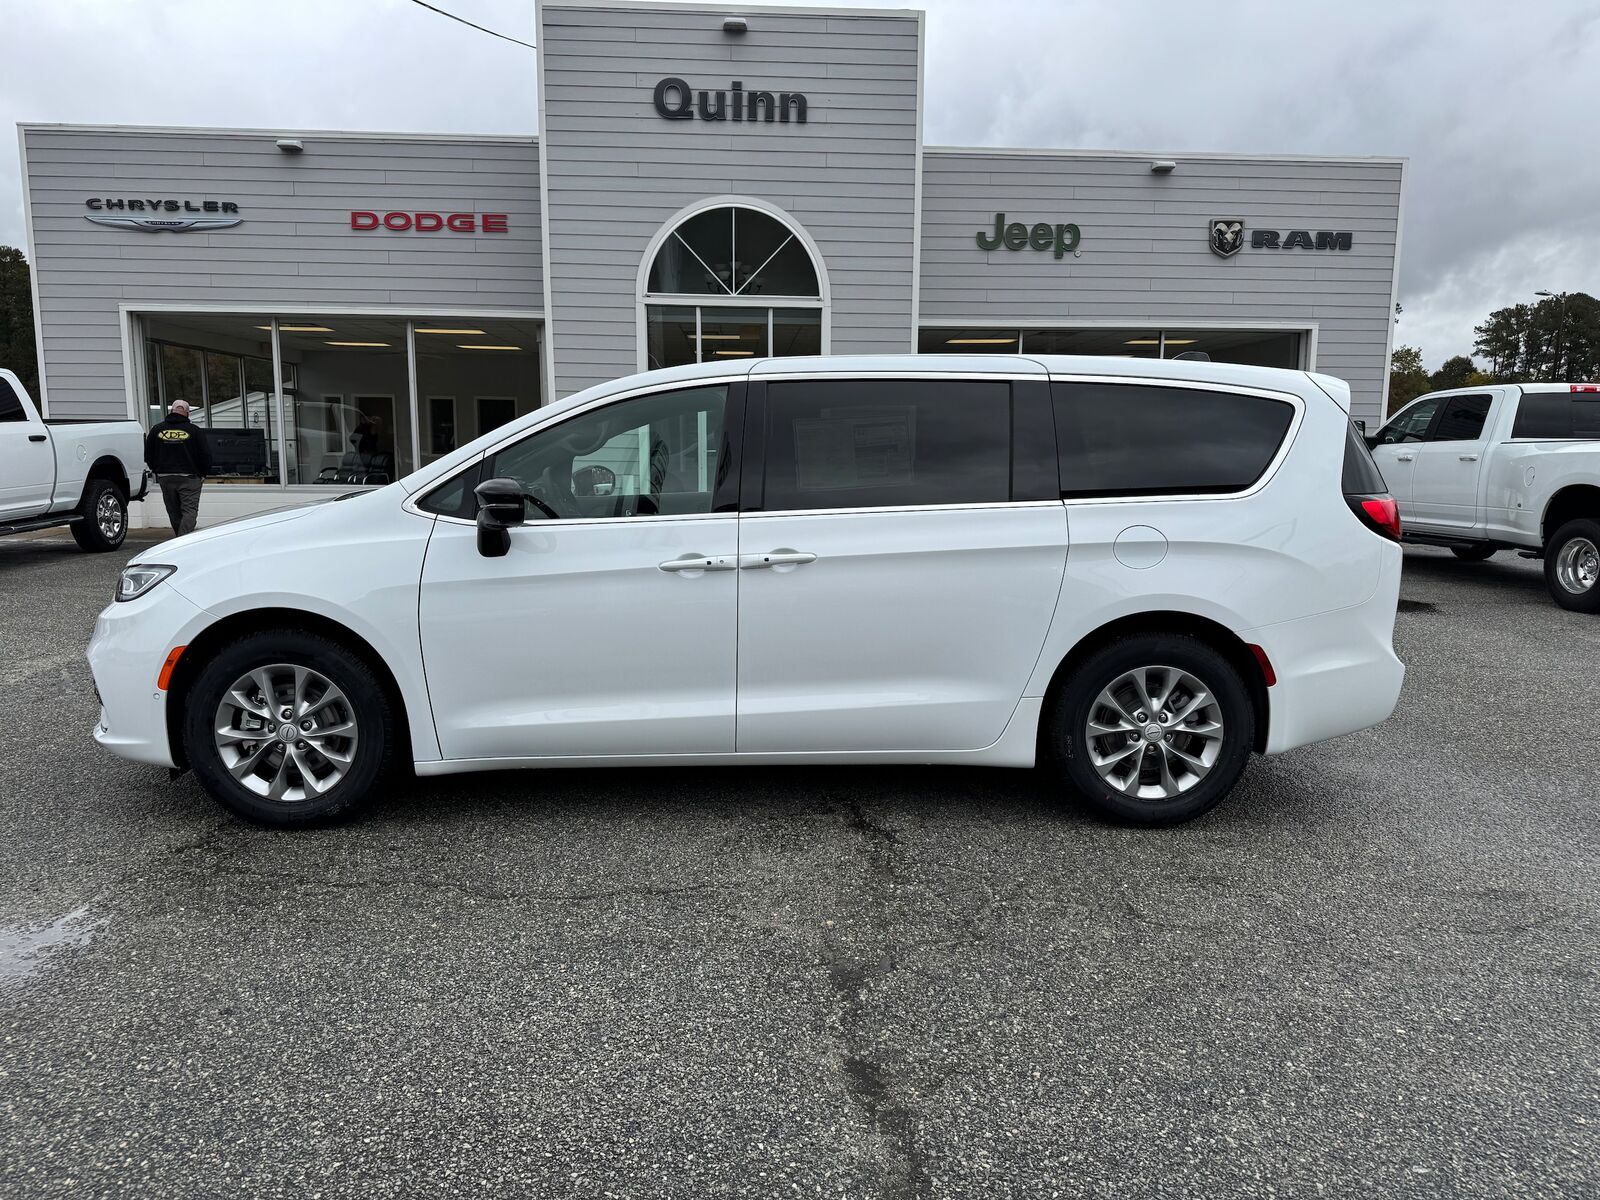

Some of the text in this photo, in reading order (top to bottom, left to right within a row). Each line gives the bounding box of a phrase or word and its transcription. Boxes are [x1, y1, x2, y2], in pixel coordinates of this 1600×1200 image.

[653, 77, 807, 123] Quinn
[85, 198, 239, 213] CHRYSLER
[351, 211, 508, 233] DODGE
[976, 213, 1080, 259] Jeep
[1251, 230, 1353, 250] RAM
[160, 430, 187, 440] XDP
